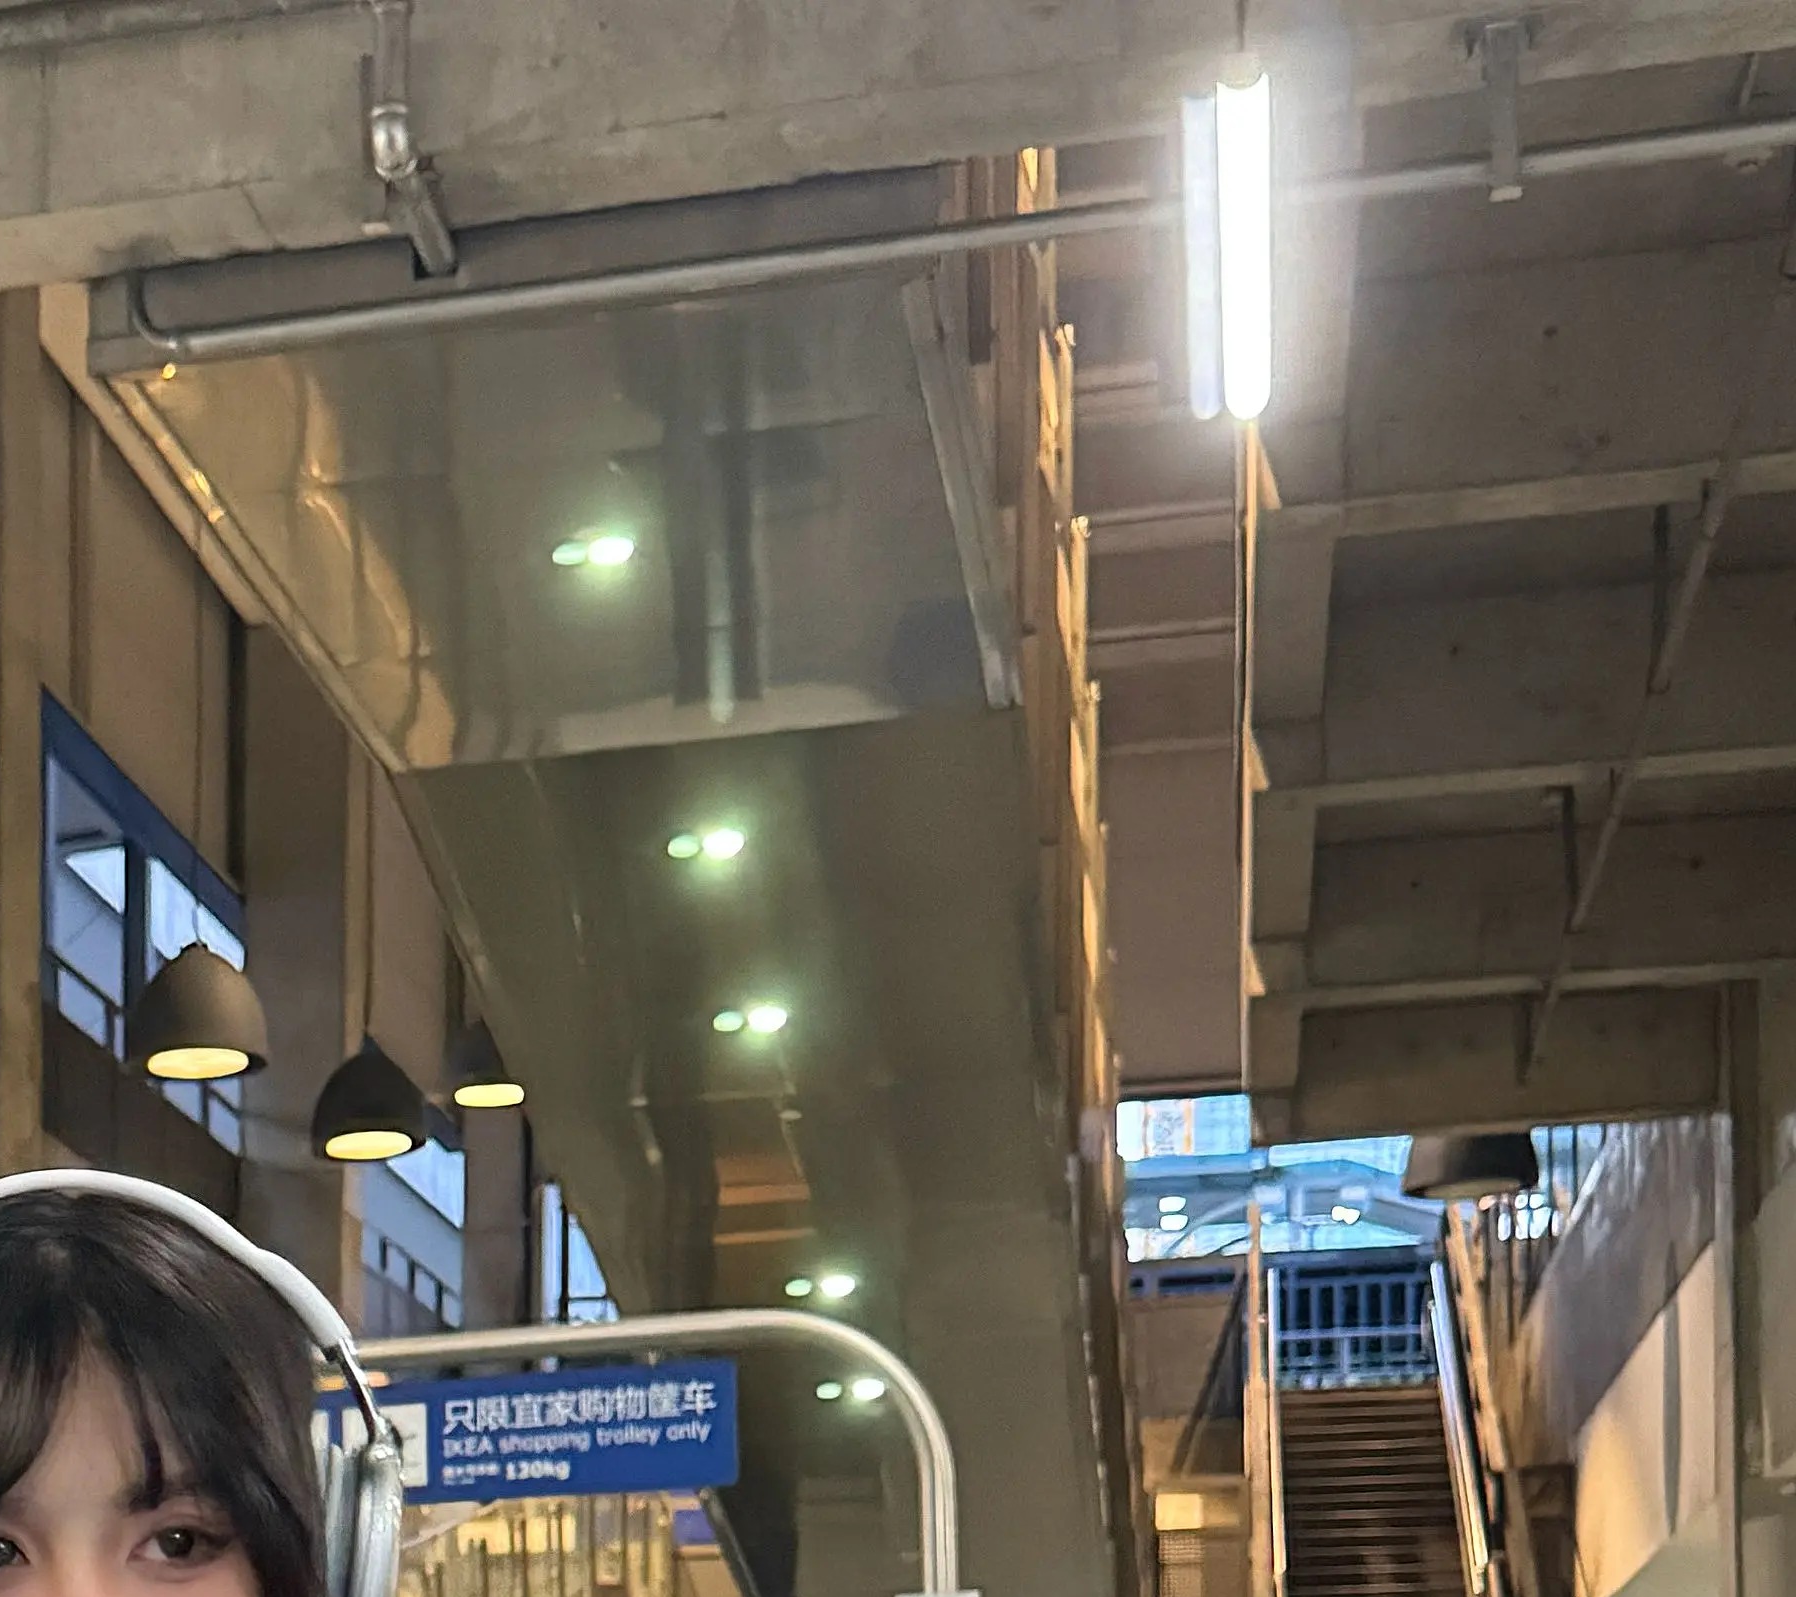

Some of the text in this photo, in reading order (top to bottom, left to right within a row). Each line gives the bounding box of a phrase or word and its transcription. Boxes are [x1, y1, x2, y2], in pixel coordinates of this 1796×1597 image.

[442, 1418, 713, 1459] IKEA shopping trolley only
[505, 1459, 571, 1481] 120kg
